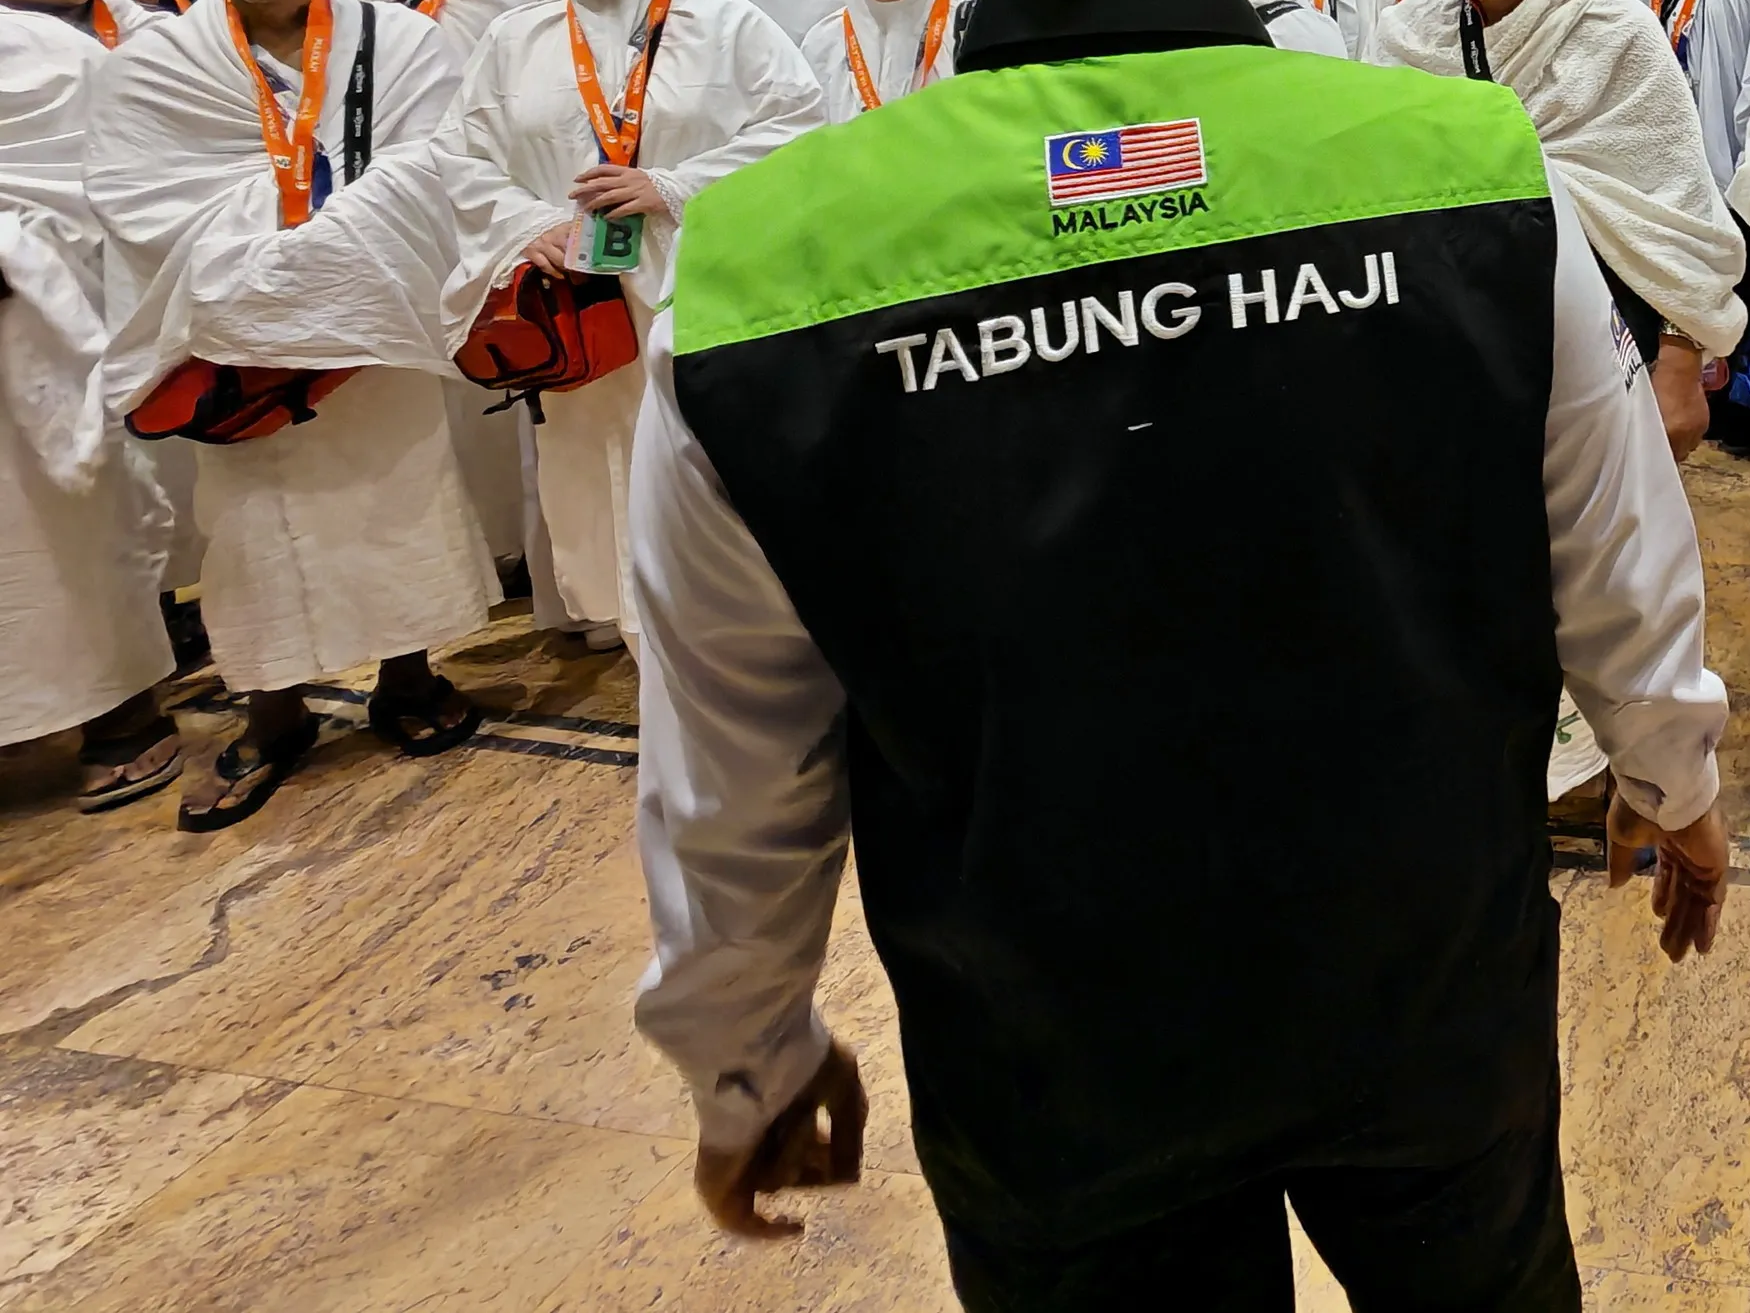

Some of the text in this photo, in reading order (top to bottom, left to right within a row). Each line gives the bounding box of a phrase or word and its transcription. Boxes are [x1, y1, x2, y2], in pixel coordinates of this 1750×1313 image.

[1052, 191, 1211, 238] MALAYSIA
[602, 221, 633, 258] B
[874, 251, 1401, 395] TABUNG HAJI
